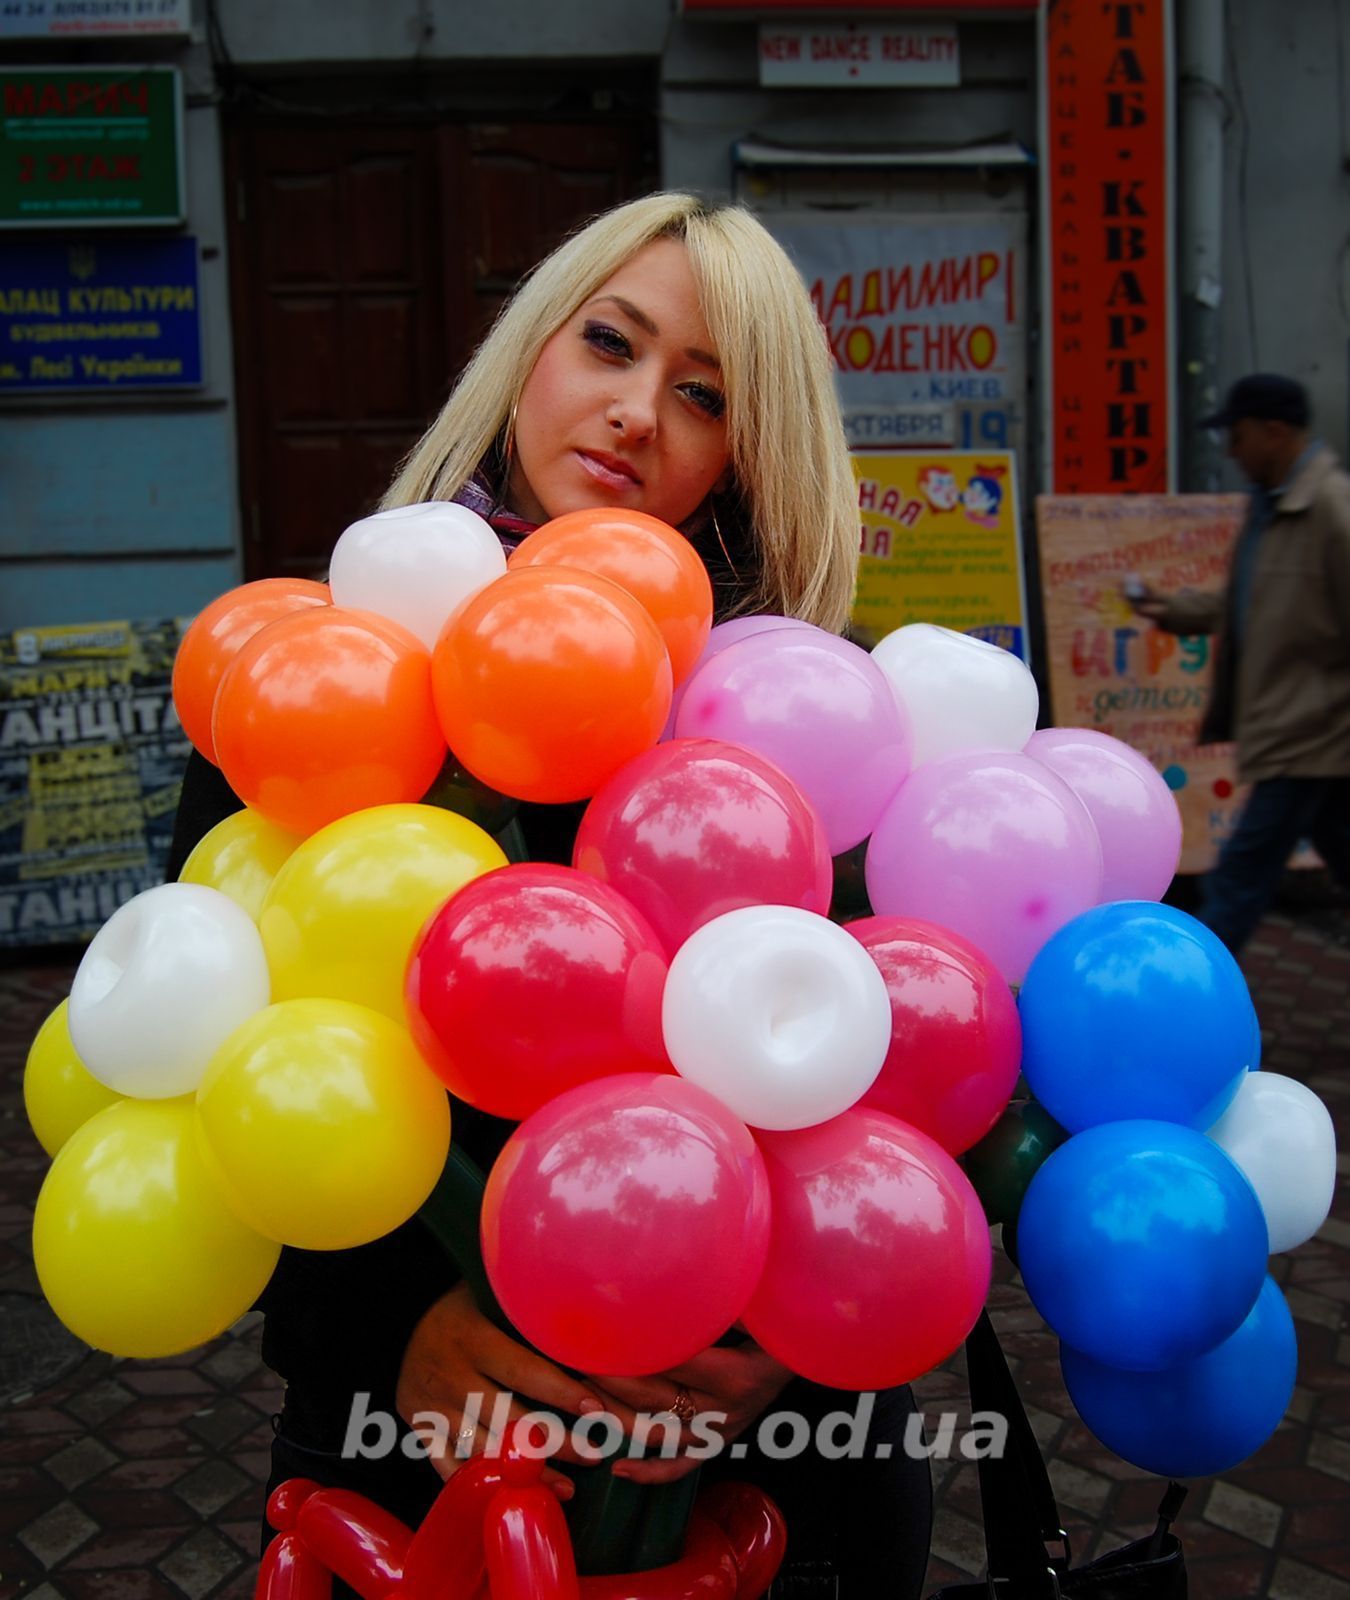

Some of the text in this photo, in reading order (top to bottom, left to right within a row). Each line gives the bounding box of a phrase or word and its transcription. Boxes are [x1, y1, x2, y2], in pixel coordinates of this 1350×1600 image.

[761, 35, 957, 61] NEW DANCE REALITY
[4, 82, 149, 116] МАРИЧ
[48, 154, 140, 181] ЭТАЖ
[68, 286, 194, 313] КУЛЬТУРИ
[1102, 181, 1150, 492] КВАРТИР
[930, 379, 1000, 399] КИЕВ
[1071, 628, 1218, 677] ИГРУ
